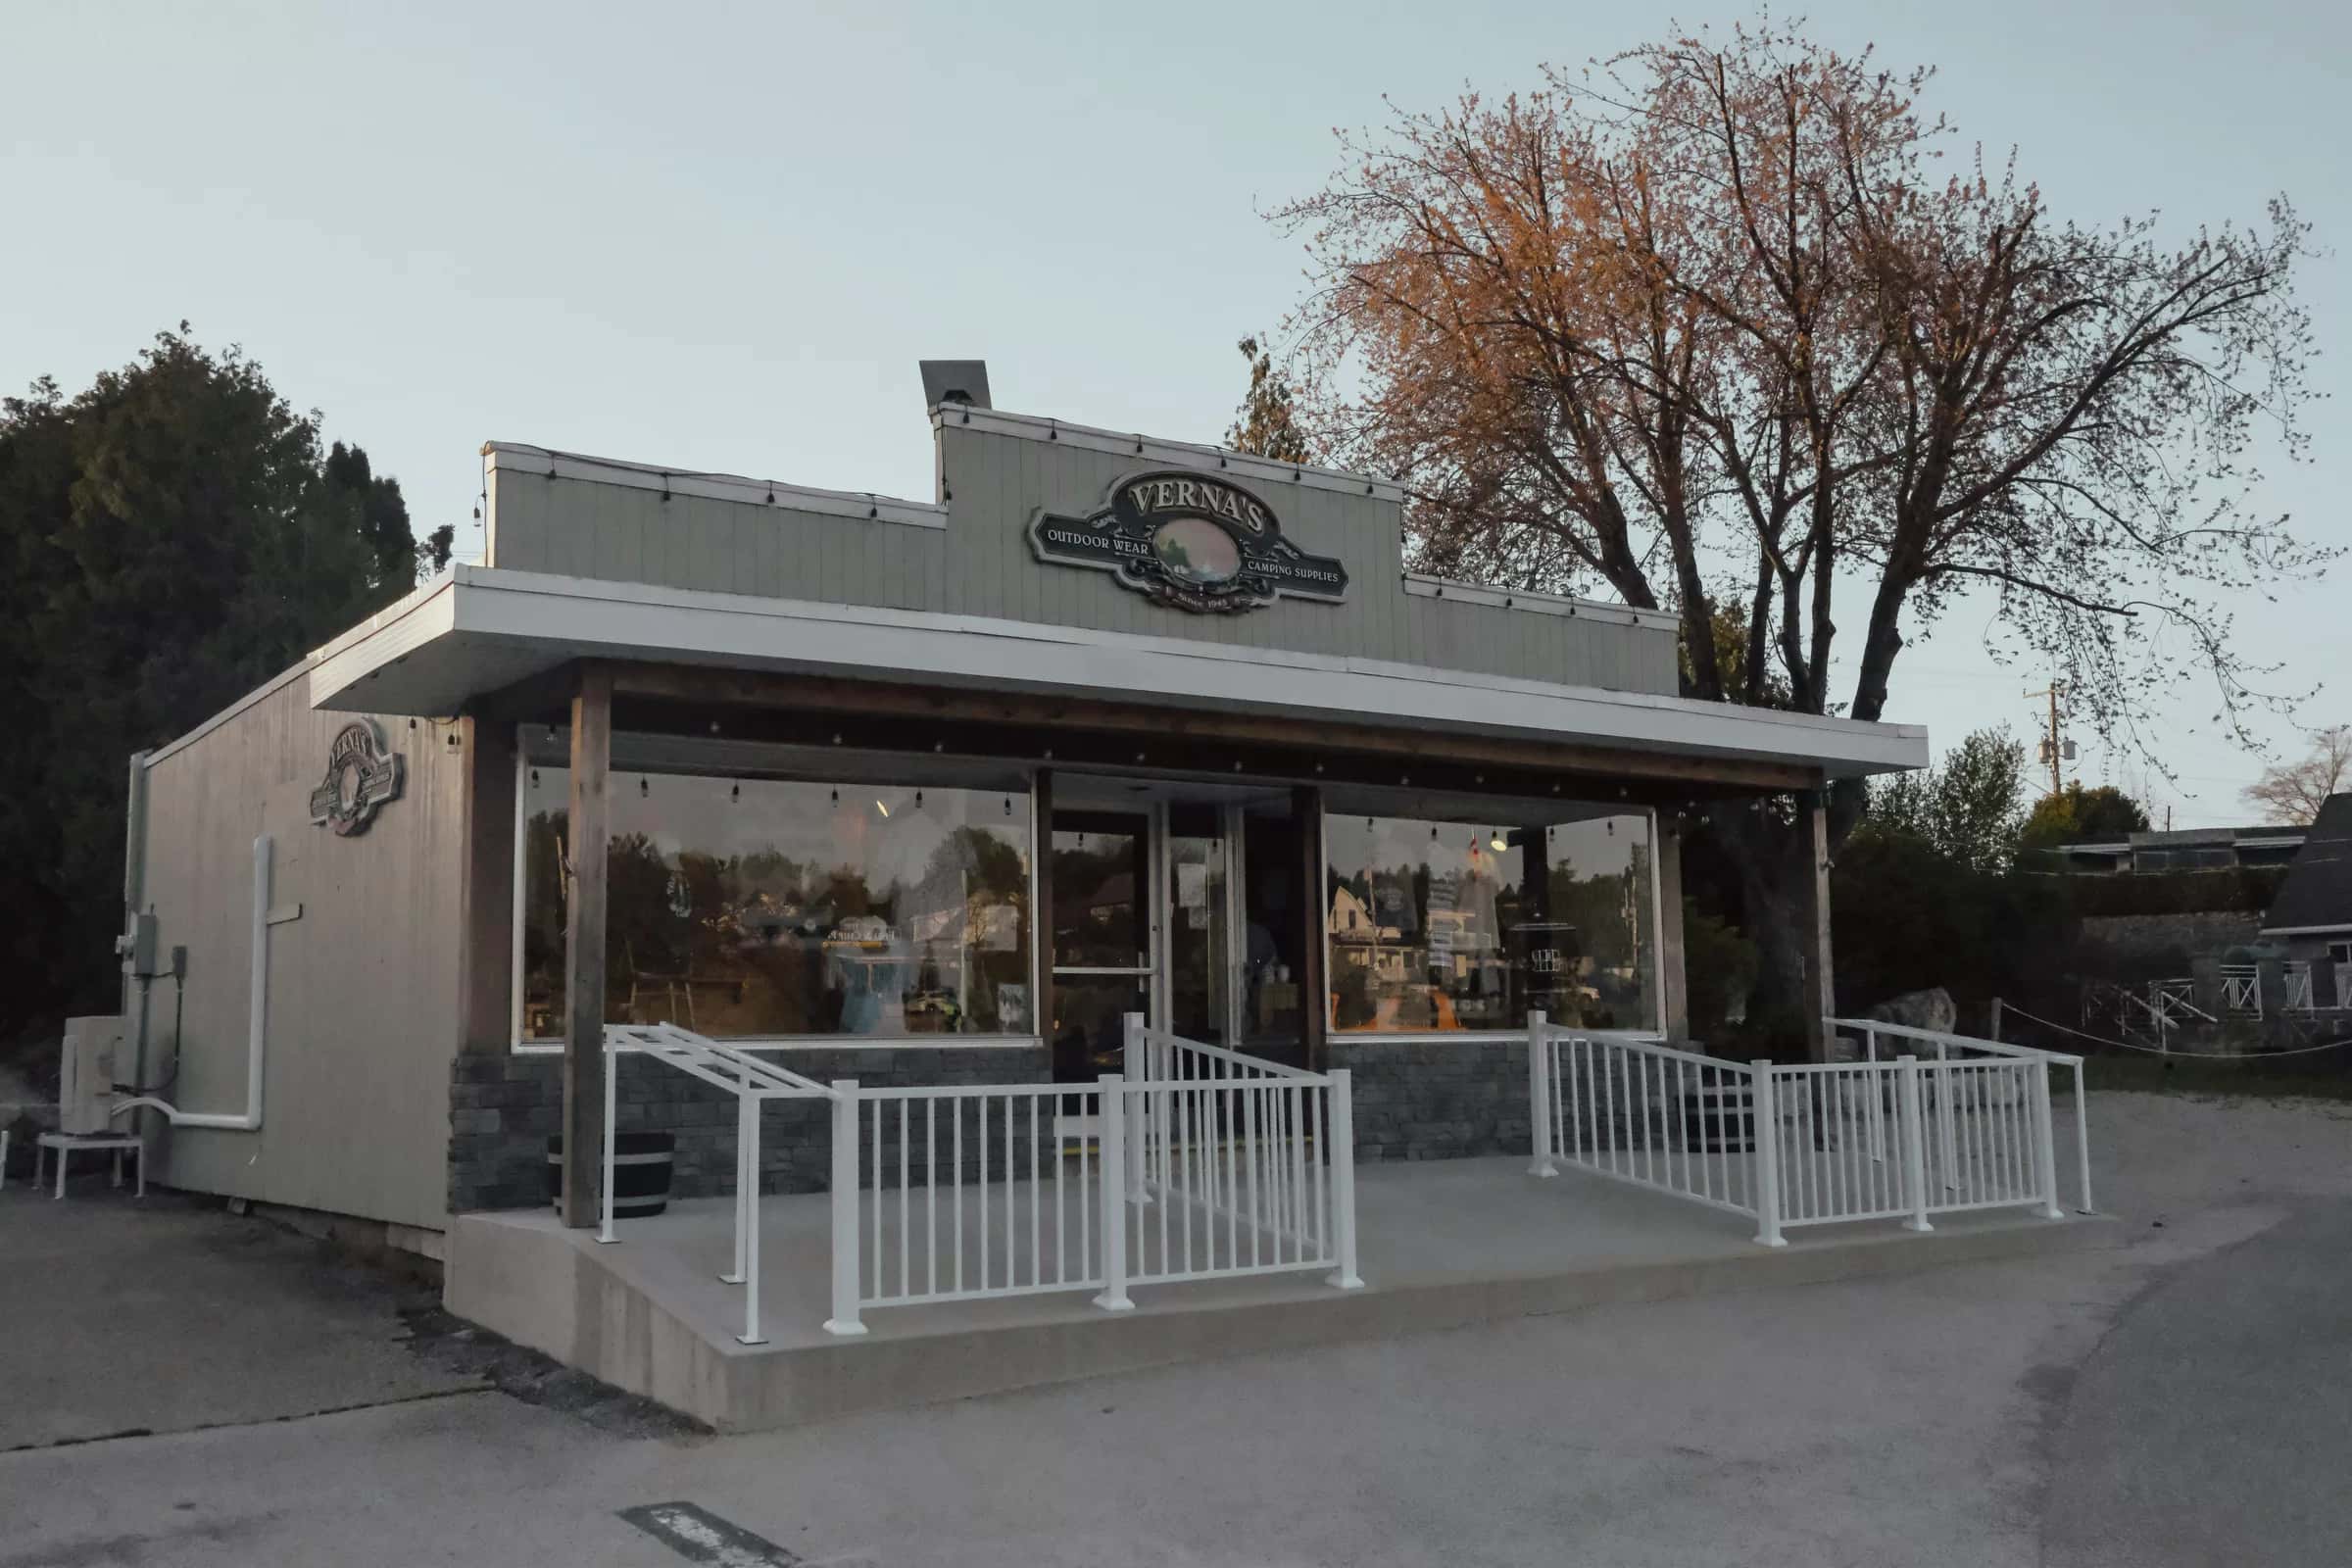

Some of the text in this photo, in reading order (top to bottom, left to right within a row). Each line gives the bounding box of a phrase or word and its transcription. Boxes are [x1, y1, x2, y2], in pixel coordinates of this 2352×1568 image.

[1130, 480, 1264, 533] VERNA'S
[1048, 529, 1149, 556] OUTDOOR WEAR
[1248, 561, 1339, 582] CAMPING SUPPLIES
